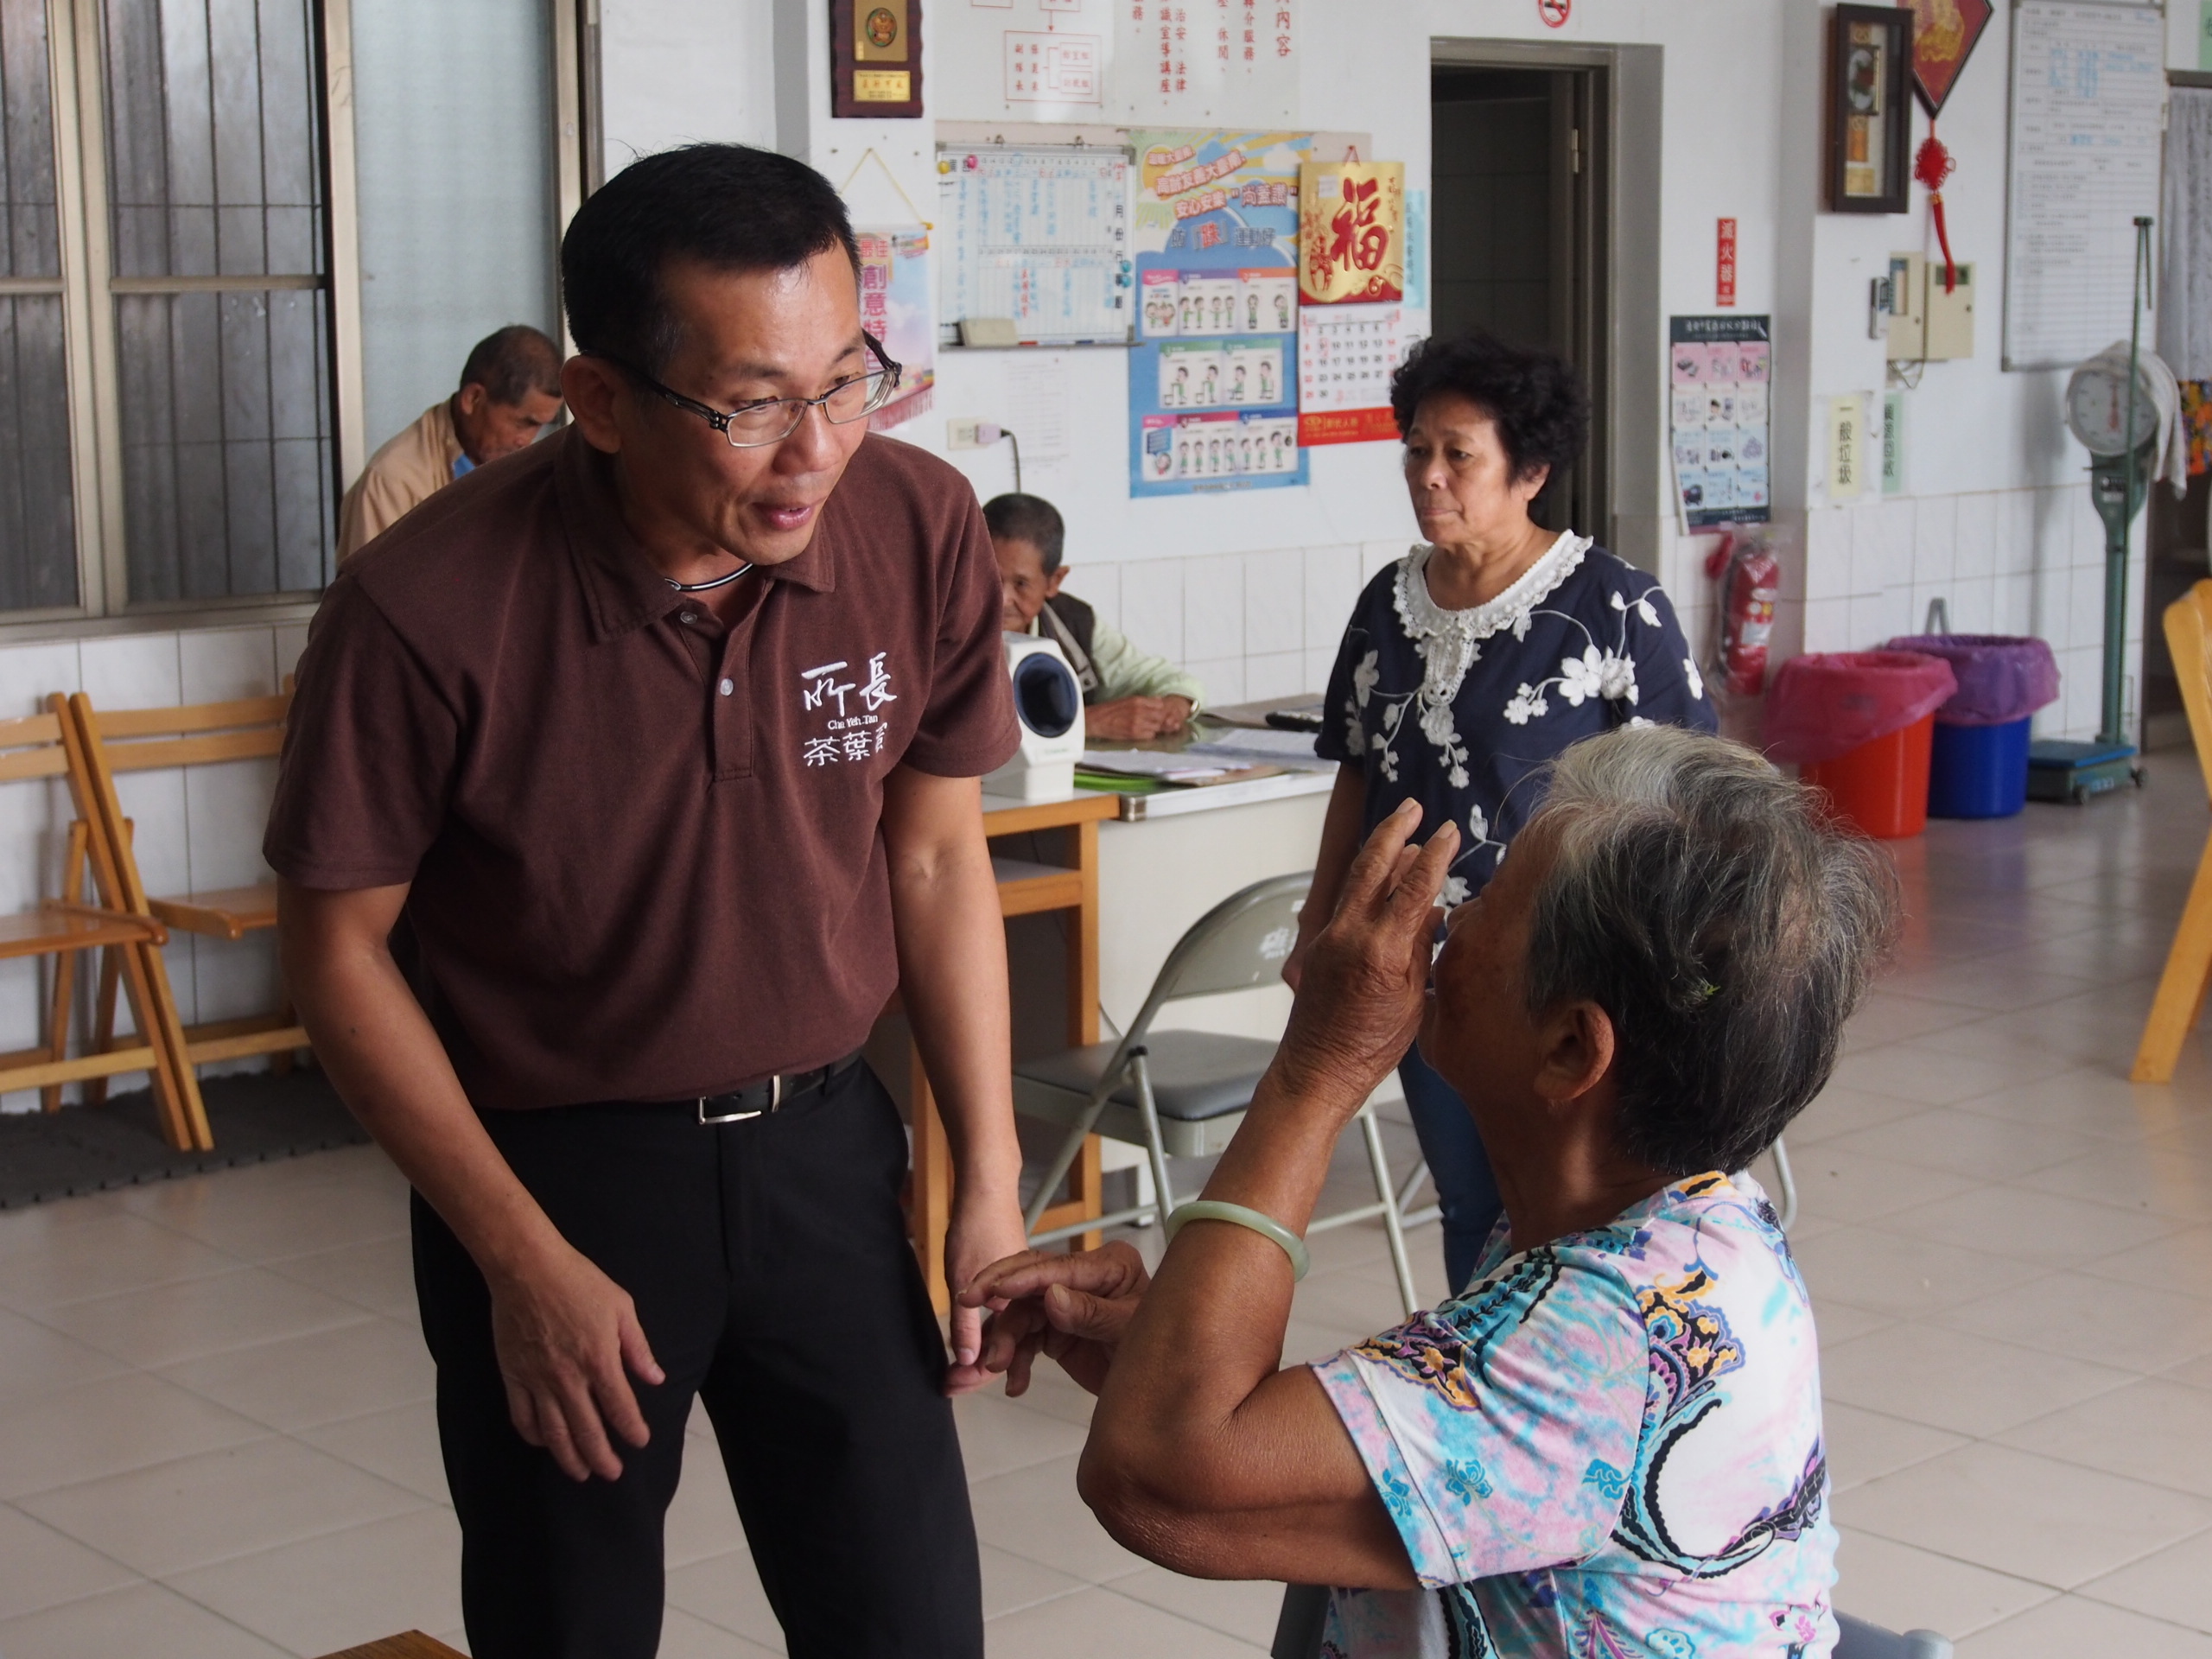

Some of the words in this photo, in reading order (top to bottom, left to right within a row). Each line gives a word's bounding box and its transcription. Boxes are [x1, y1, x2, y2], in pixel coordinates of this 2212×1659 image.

[1160, 0, 1172, 105] 識宣導講座。
[1274, 0, 1291, 57] 內容
[1331, 177, 1389, 270] 福
[1838, 406, 1853, 485] 一般垃圾
[801, 652, 898, 717] 所長
[827, 719, 845, 730] Cha
